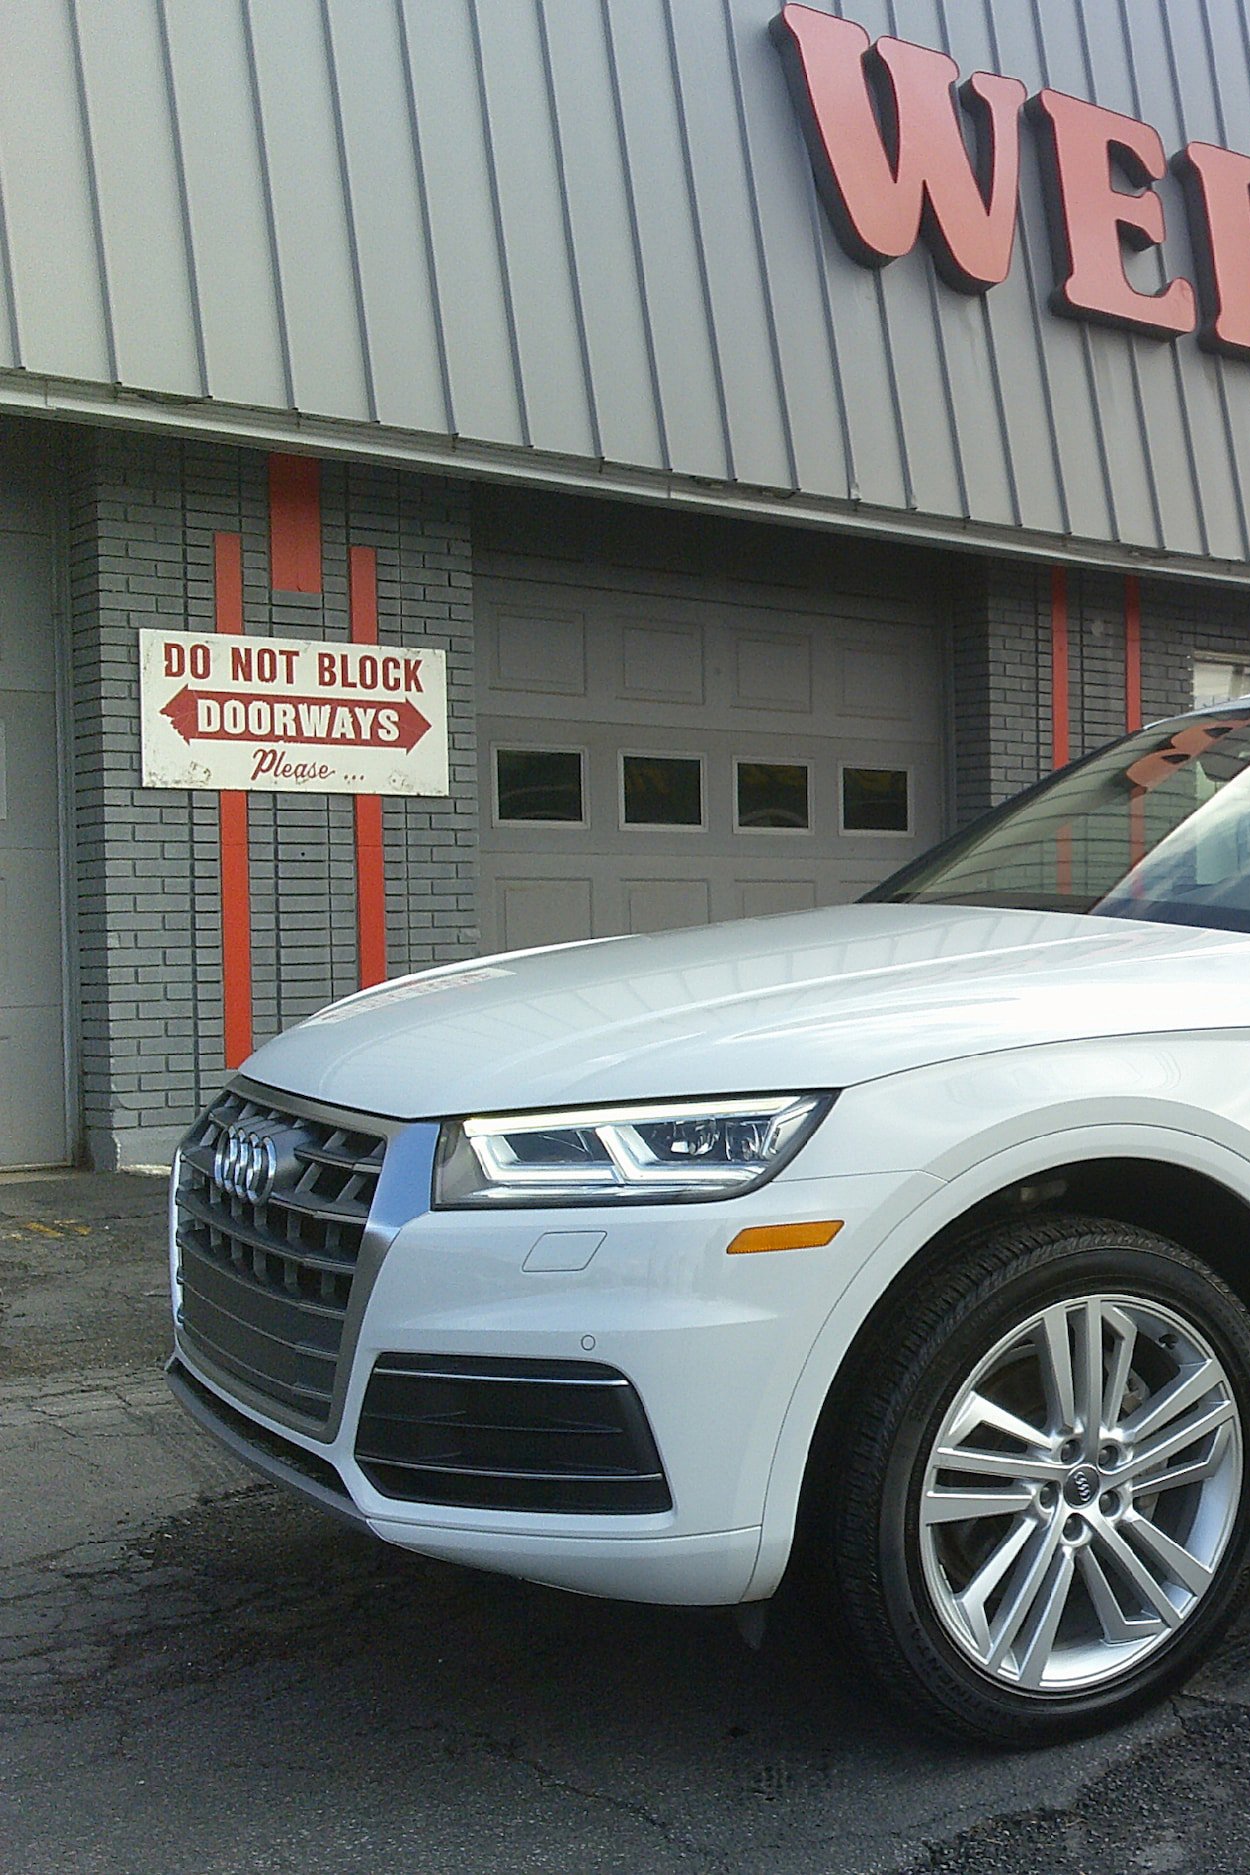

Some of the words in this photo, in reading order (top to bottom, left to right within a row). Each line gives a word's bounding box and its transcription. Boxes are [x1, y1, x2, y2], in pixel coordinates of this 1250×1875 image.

[164, 643, 212, 680] DO
[231, 647, 300, 685] NOT
[318, 652, 424, 693] BLOCK
[197, 699, 400, 742] DOORWAYS
[251, 748, 336, 781] Please
